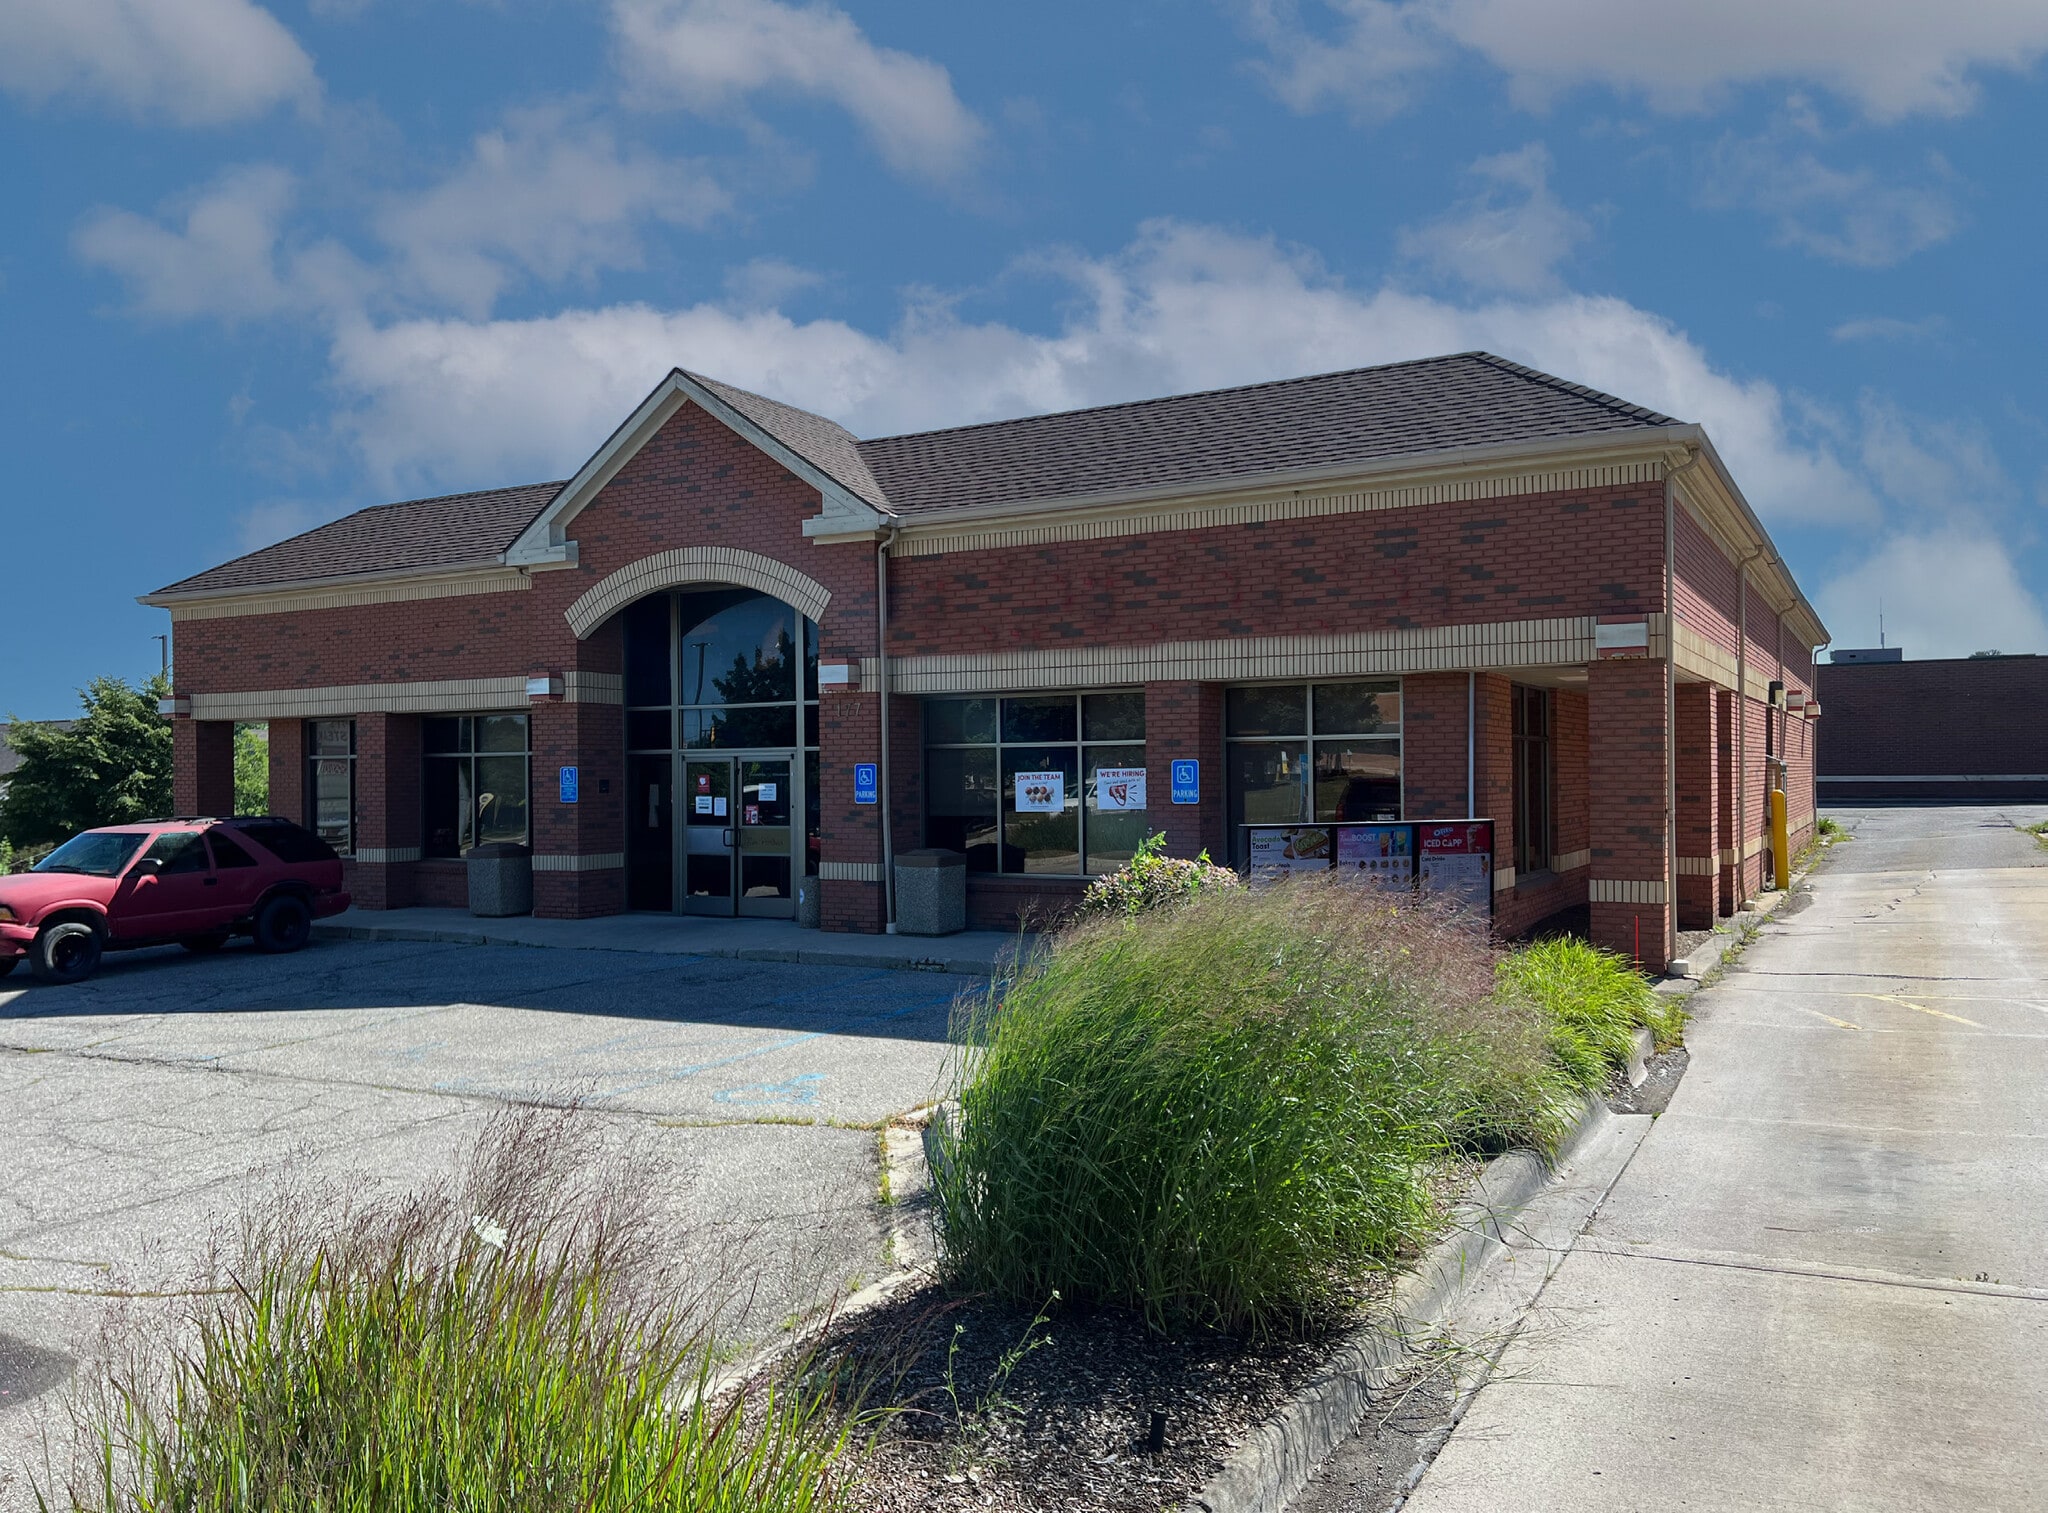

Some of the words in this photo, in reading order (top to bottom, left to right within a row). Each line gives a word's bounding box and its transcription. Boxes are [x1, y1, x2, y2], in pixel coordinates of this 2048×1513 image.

[1017, 774, 1031, 782] JOIN
[856, 790, 876, 799] PARKING
[1173, 789, 1198, 798] PARKING
[1252, 835, 1281, 843] Avocado
[1351, 833, 1377, 842] BOOST
[1252, 842, 1270, 850] Toast
[1423, 839, 1441, 848] ICED
